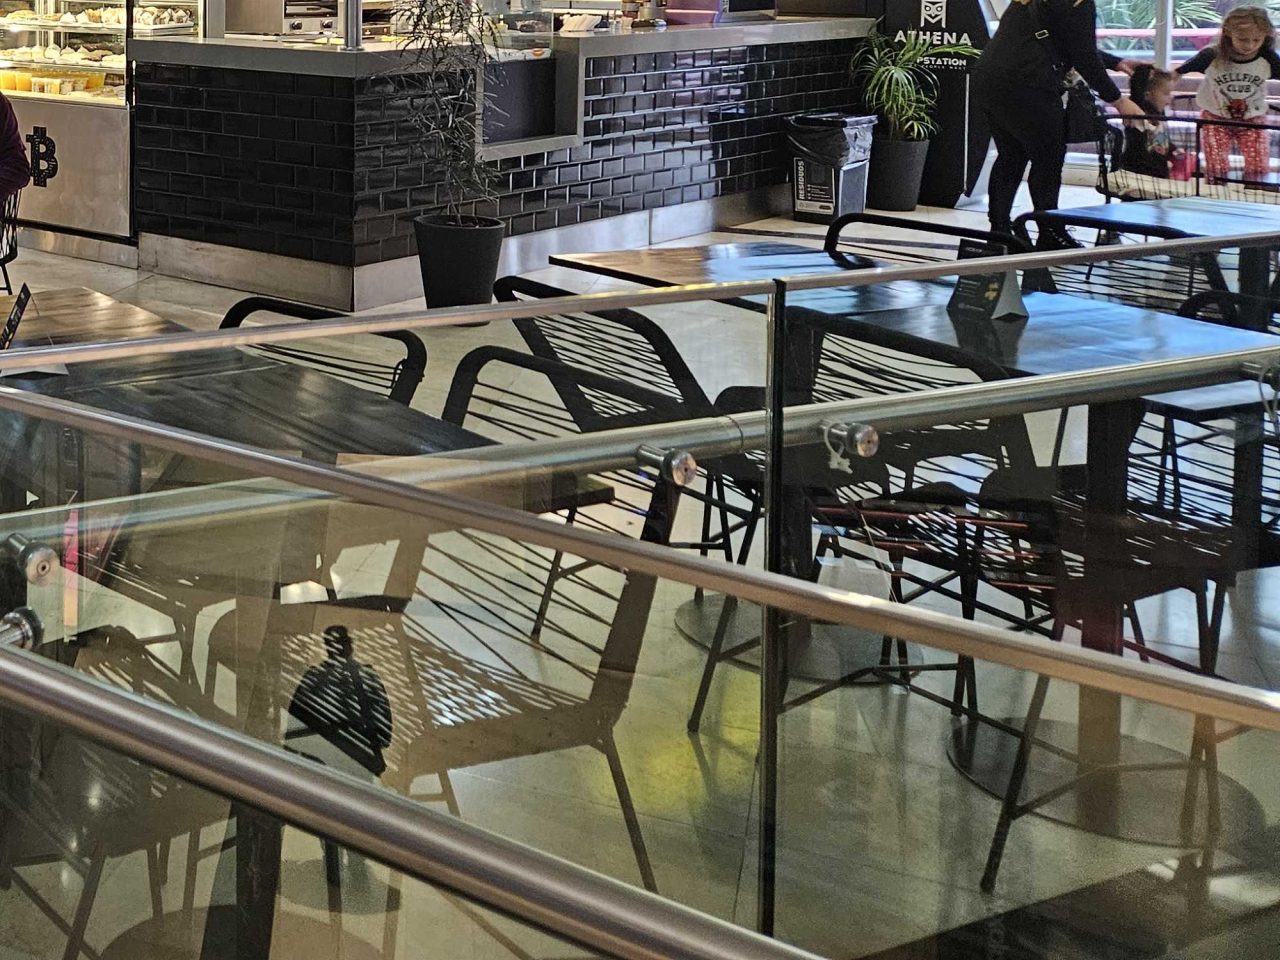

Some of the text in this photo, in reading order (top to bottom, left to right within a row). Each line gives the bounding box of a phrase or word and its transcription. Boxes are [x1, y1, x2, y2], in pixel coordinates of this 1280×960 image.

[894, 30, 972, 46] ATHENA
[916, 56, 967, 66] PSTATION
[1226, 84, 1252, 93] CLUB
